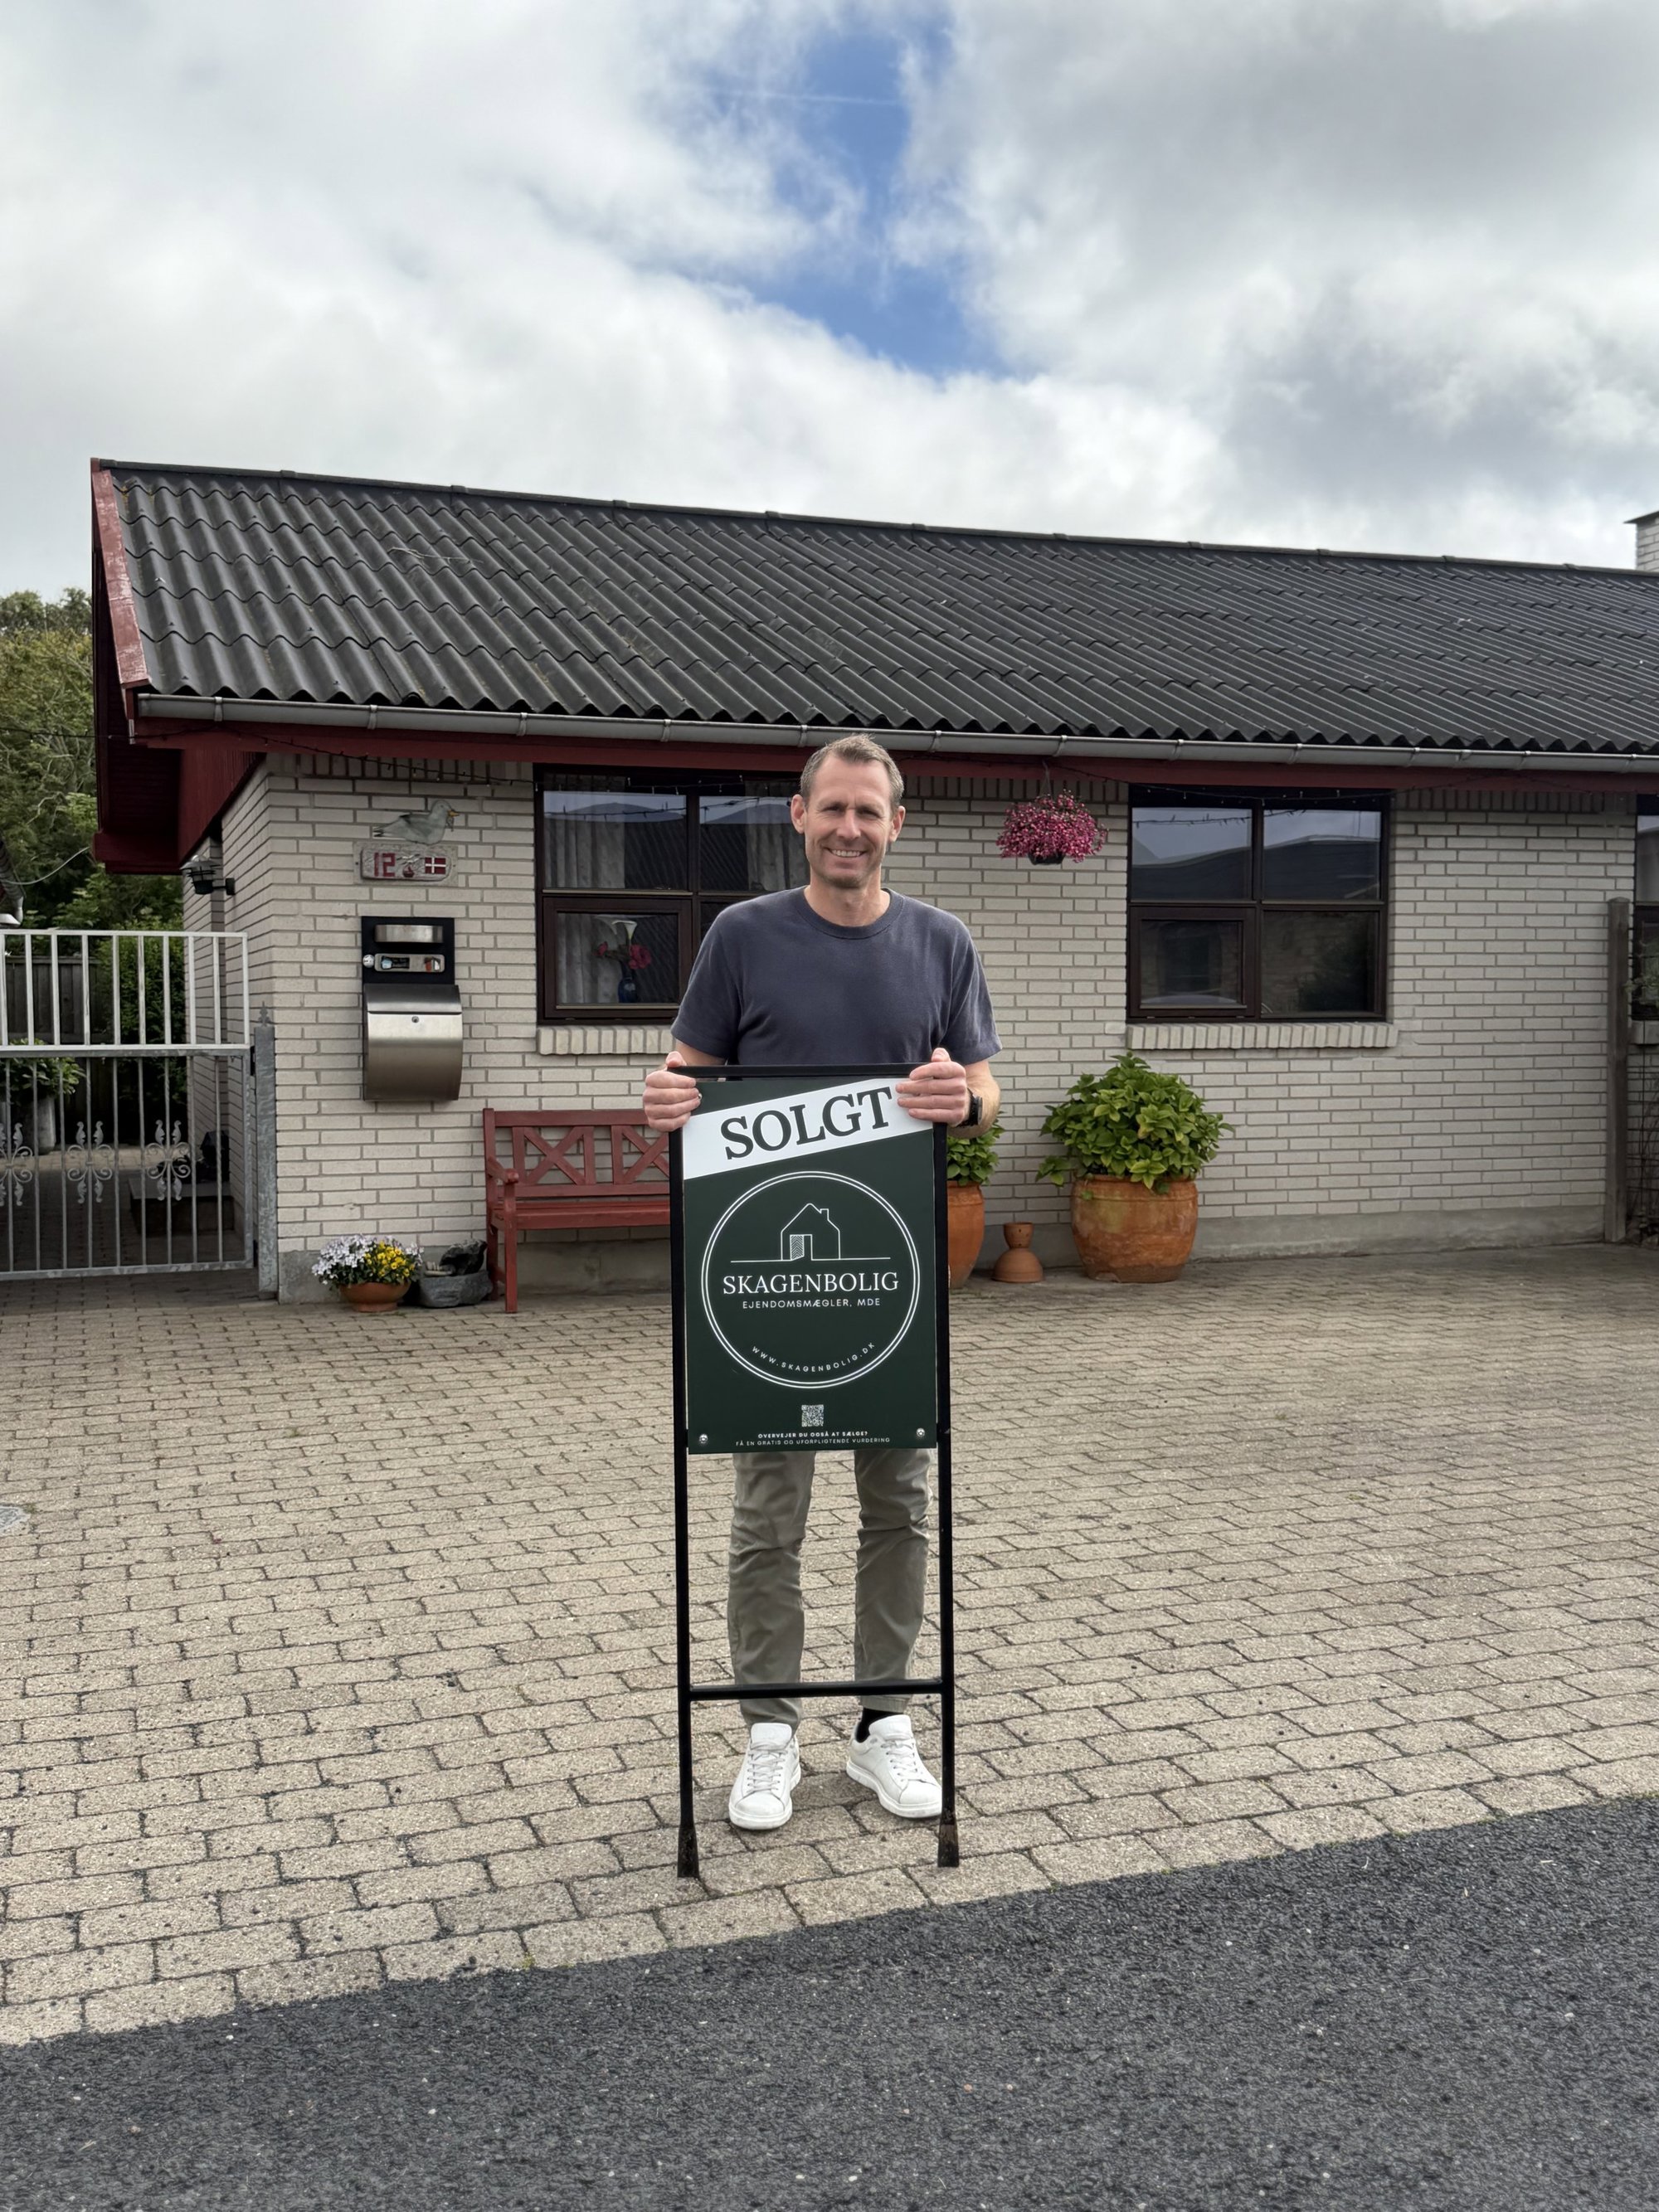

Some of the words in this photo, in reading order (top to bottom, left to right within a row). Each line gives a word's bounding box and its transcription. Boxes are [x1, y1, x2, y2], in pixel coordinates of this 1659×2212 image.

[373, 852, 396, 878] 12
[720, 1086, 893, 1160] SOLGT
[722, 1271, 899, 1295] SKAGENBOLIG
[742, 1299, 853, 1309] EJENDOMSMÆGLER,
[857, 1297, 881, 1307] MDE
[752, 1341, 875, 1373] WWW.SKAGENBOLIG.DK
